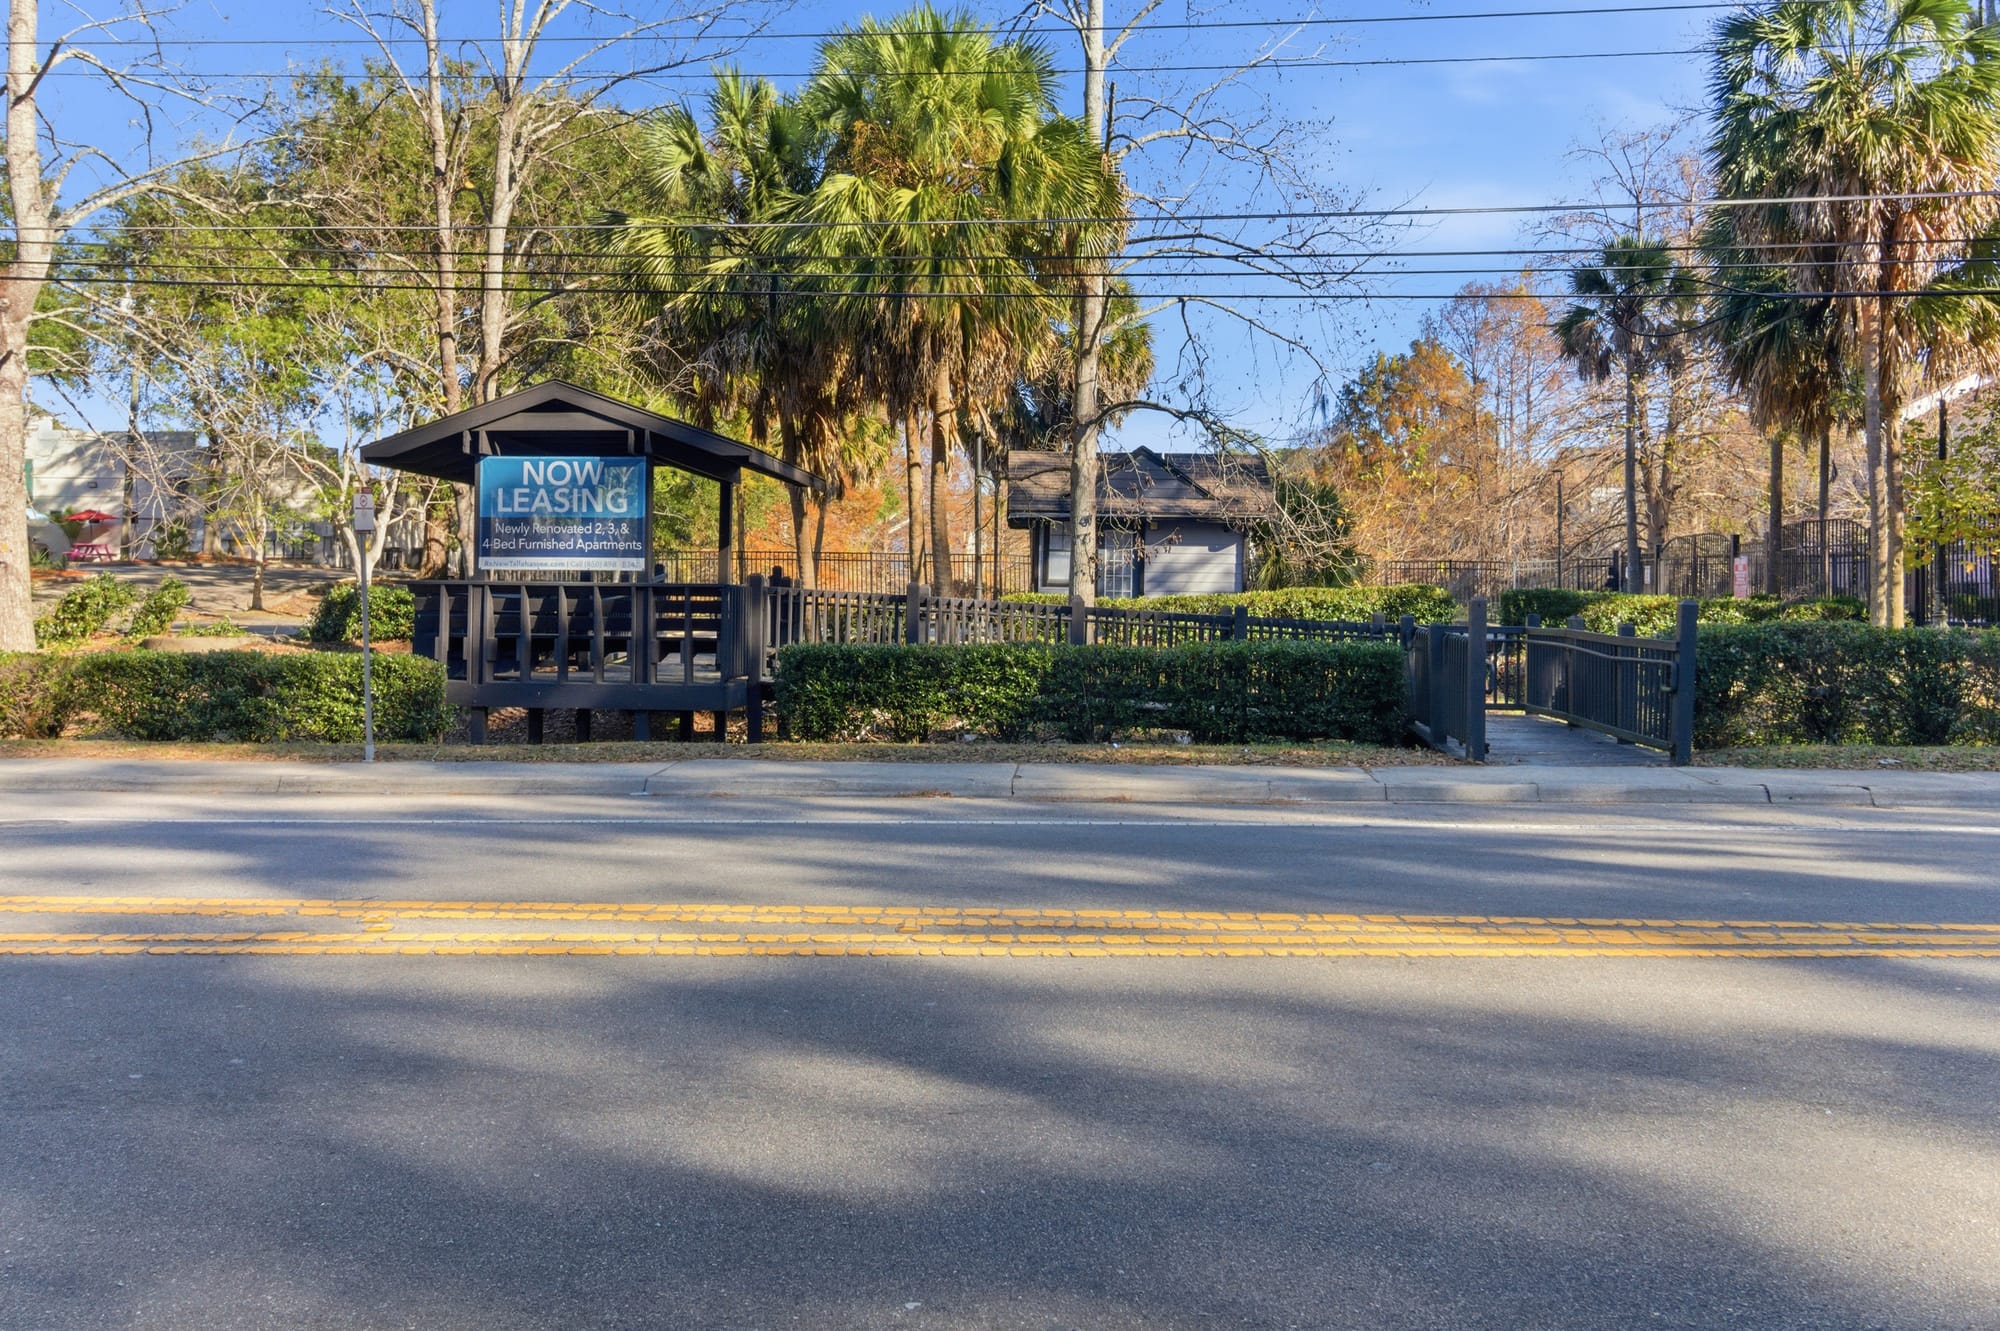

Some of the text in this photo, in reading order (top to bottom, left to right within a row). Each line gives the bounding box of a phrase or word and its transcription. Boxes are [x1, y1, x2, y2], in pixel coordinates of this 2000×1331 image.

[523, 460, 604, 486] NOW
[497, 487, 628, 513] LEASING
[495, 522, 630, 536] Newly Renovated 2, 3, &
[482, 538, 642, 552] 4-Bed Furnished Apartments
